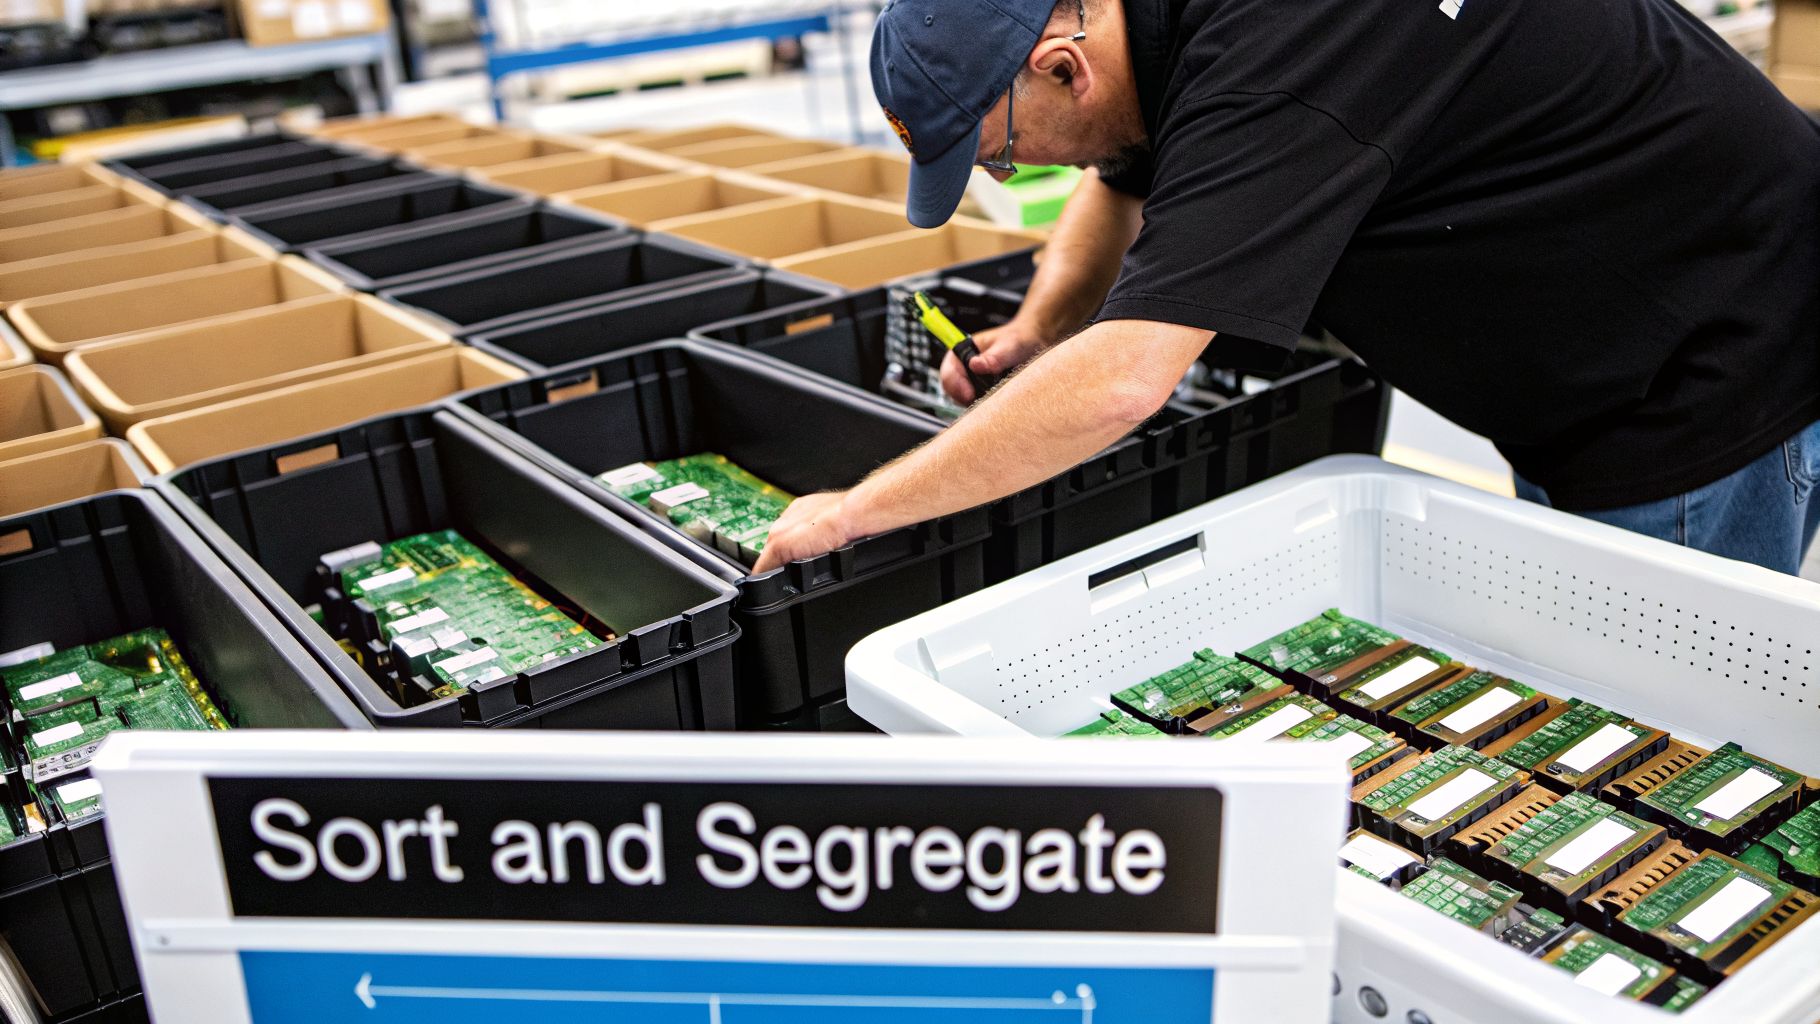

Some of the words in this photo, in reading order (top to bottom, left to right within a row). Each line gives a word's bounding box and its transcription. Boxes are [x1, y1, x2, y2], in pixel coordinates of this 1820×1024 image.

[251, 798, 464, 884] Sort
[491, 803, 665, 885] and
[696, 802, 1167, 911] Segregate
